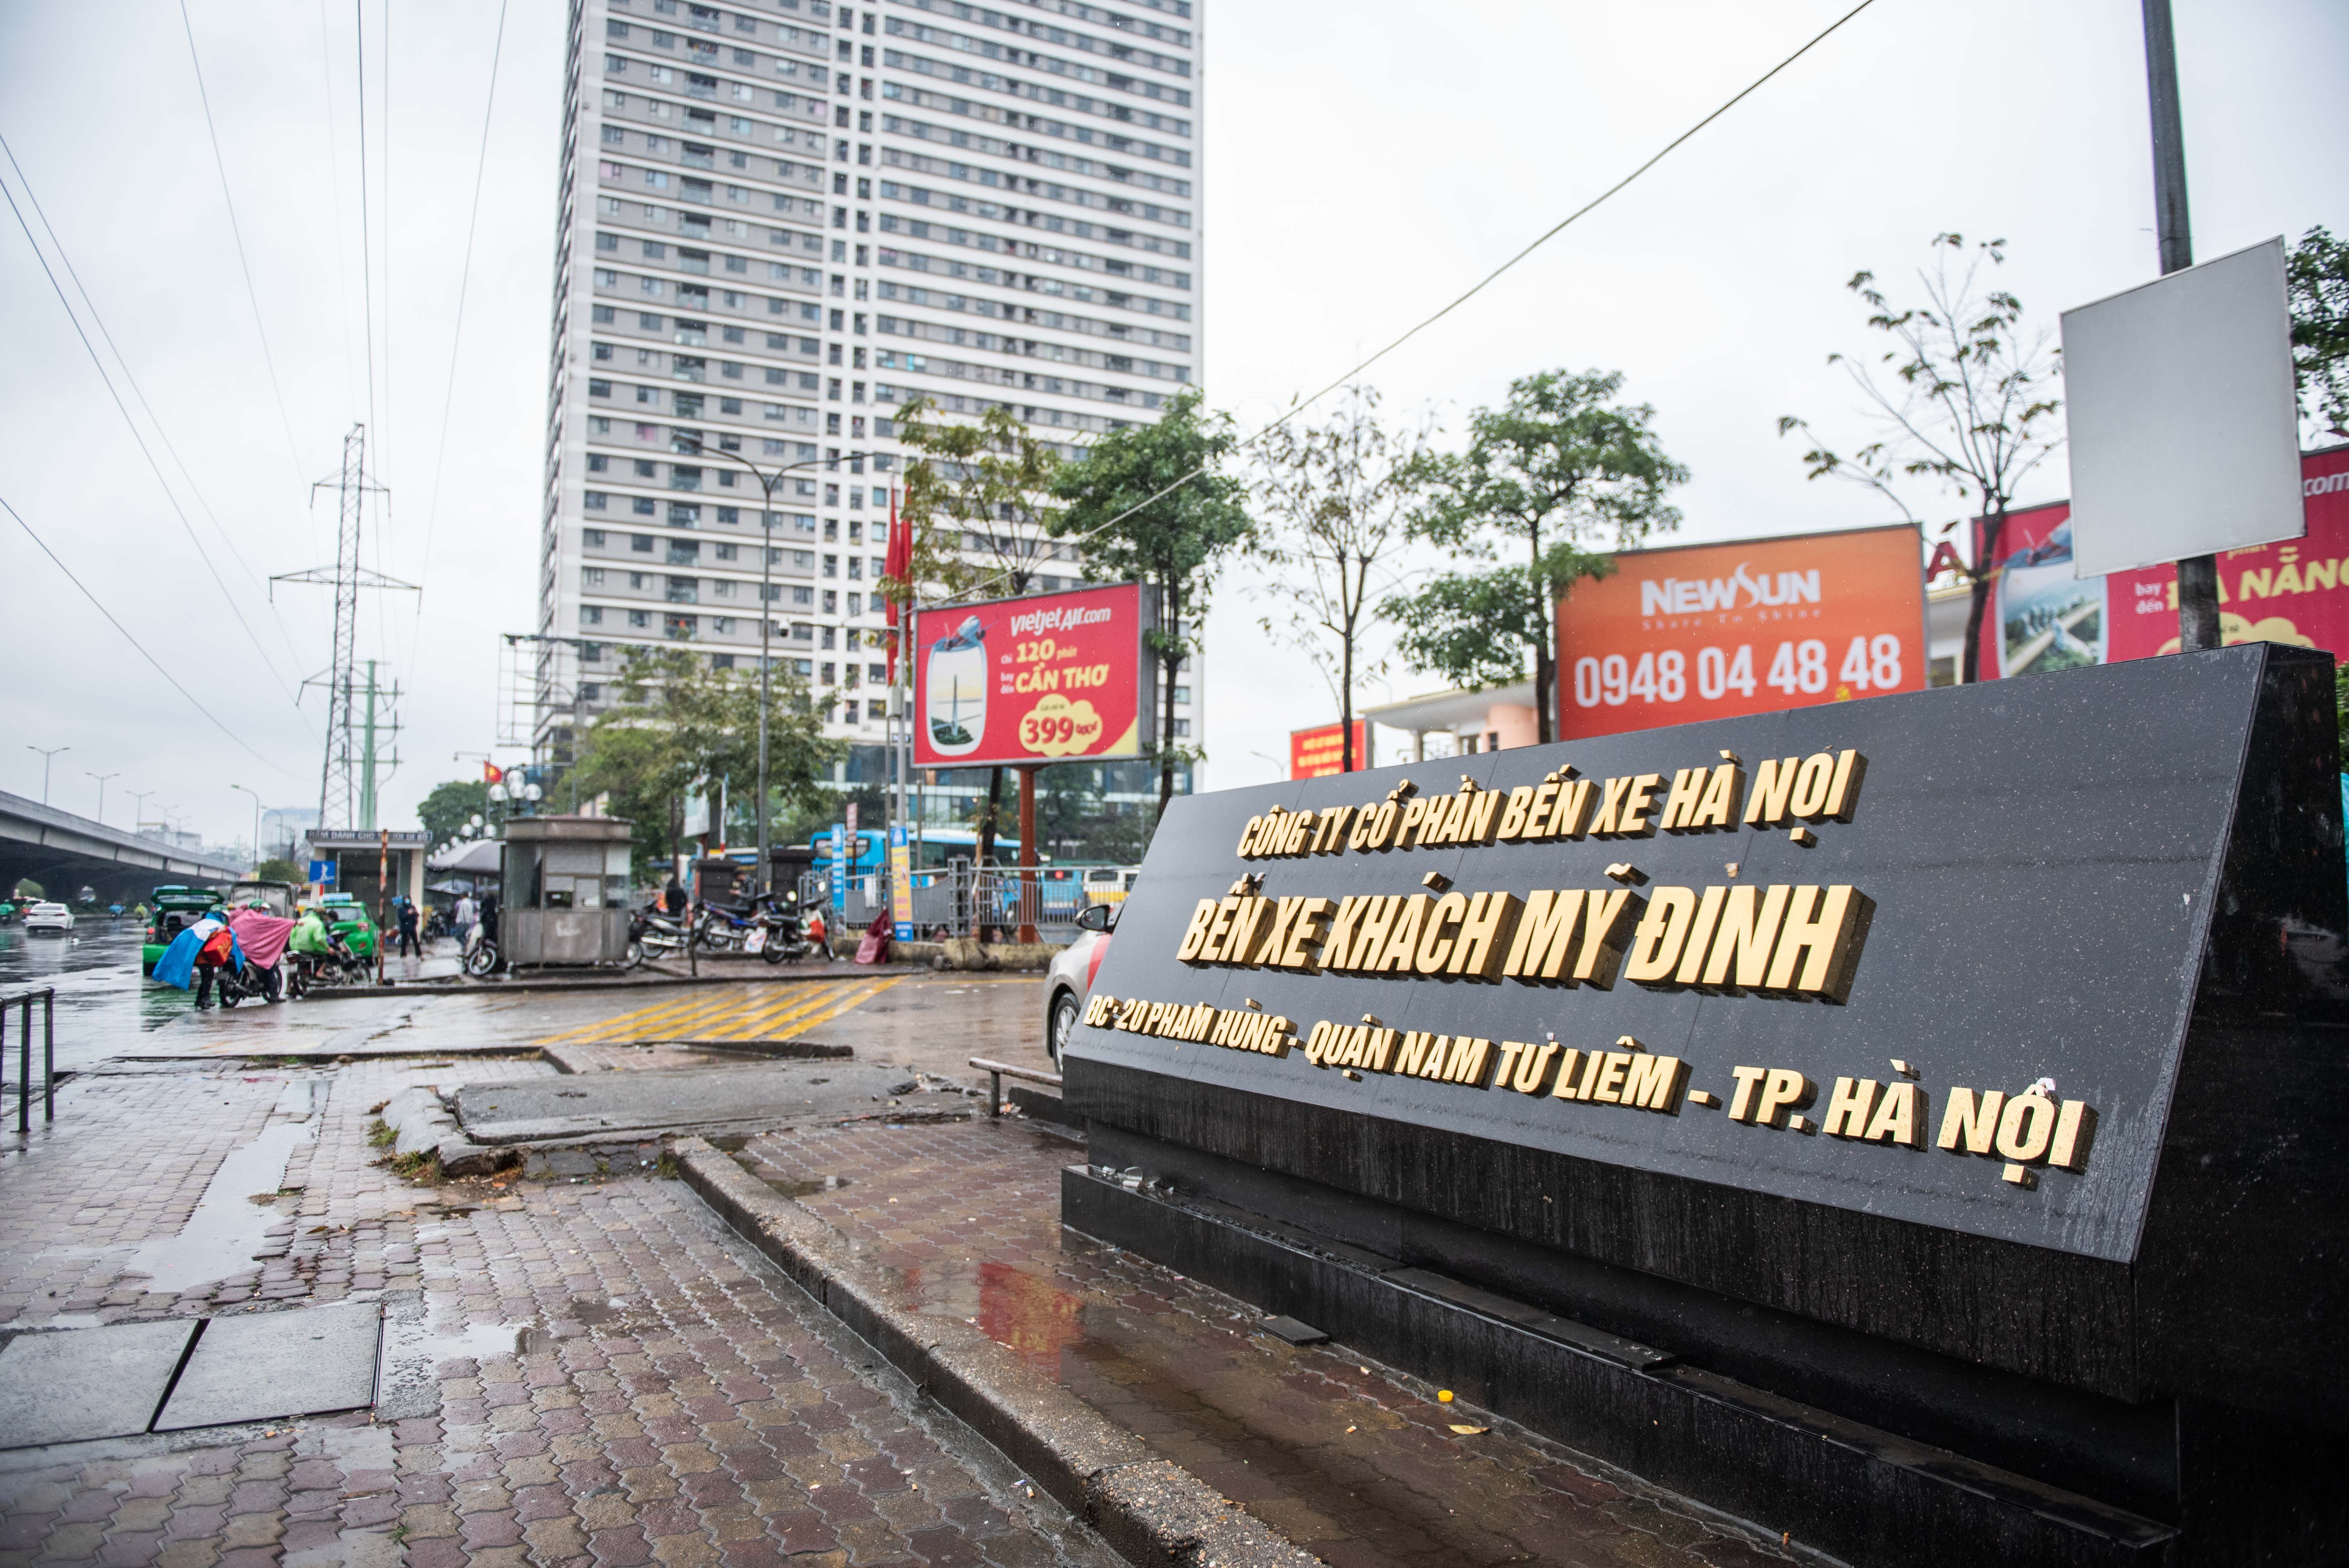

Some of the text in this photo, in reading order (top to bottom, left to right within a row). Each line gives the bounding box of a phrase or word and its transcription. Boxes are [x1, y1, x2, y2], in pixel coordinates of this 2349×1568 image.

[2135, 582, 2162, 597] bay
[1016, 638, 1055, 663] 120
[1575, 633, 1902, 707] 0948 04 48 48
[1063, 664, 1110, 689] THƠ
[1024, 716, 1074, 744] 399
[1237, 804, 1313, 857] CÔNG
[1310, 805, 1354, 852] TY
[1348, 779, 1409, 849] CỔ
[1394, 774, 1500, 847] PHẦN
[1496, 764, 1592, 840] BẾN
[1588, 773, 1660, 834] XE
[1659, 750, 1736, 829] HÀ
[1175, 872, 1268, 962] BẾN
[1253, 896, 1328, 967] XE
[1317, 871, 1509, 975] KHÁCH
[1502, 862, 1632, 979] MỸ
[1115, 998, 1149, 1032] 20
[1210, 998, 1288, 1054] HÙNG
[1305, 1013, 1396, 1078] QUẬN
[1394, 1030, 1491, 1083] NAM
[1552, 1035, 1679, 1109] LIÊM
[1728, 1065, 1805, 1130] TP.
[1822, 1058, 1915, 1145] HÀ
[1936, 1082, 2086, 1183] NỘI
